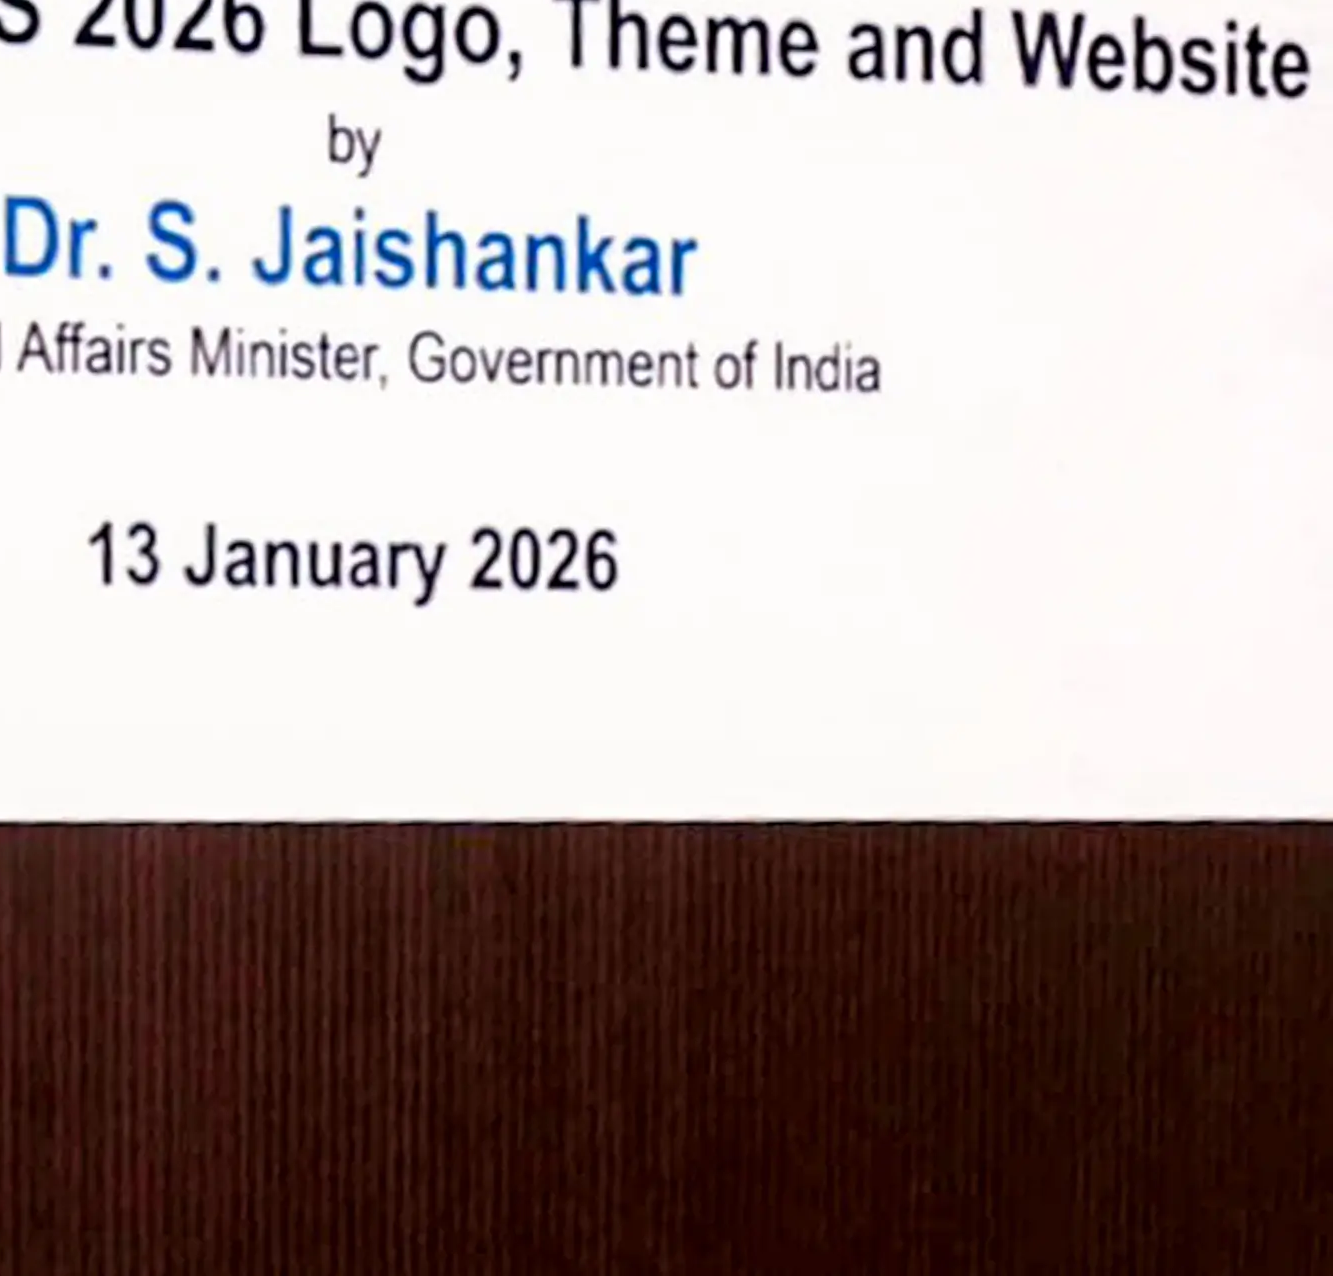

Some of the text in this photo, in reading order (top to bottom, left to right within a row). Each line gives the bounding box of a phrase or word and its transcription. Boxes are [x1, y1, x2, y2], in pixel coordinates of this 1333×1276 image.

[848, 8, 983, 85] and
[1011, 10, 1310, 99] Website
[329, 114, 381, 178] by
[4, 196, 698, 296] Dr. S. Jaishankar
[17, 322, 171, 376] Affairs
[192, 327, 389, 386] Minister,
[409, 331, 698, 388] Government
[715, 340, 757, 389] of
[776, 342, 880, 392] India
[89, 522, 617, 607] 13 January 2026
